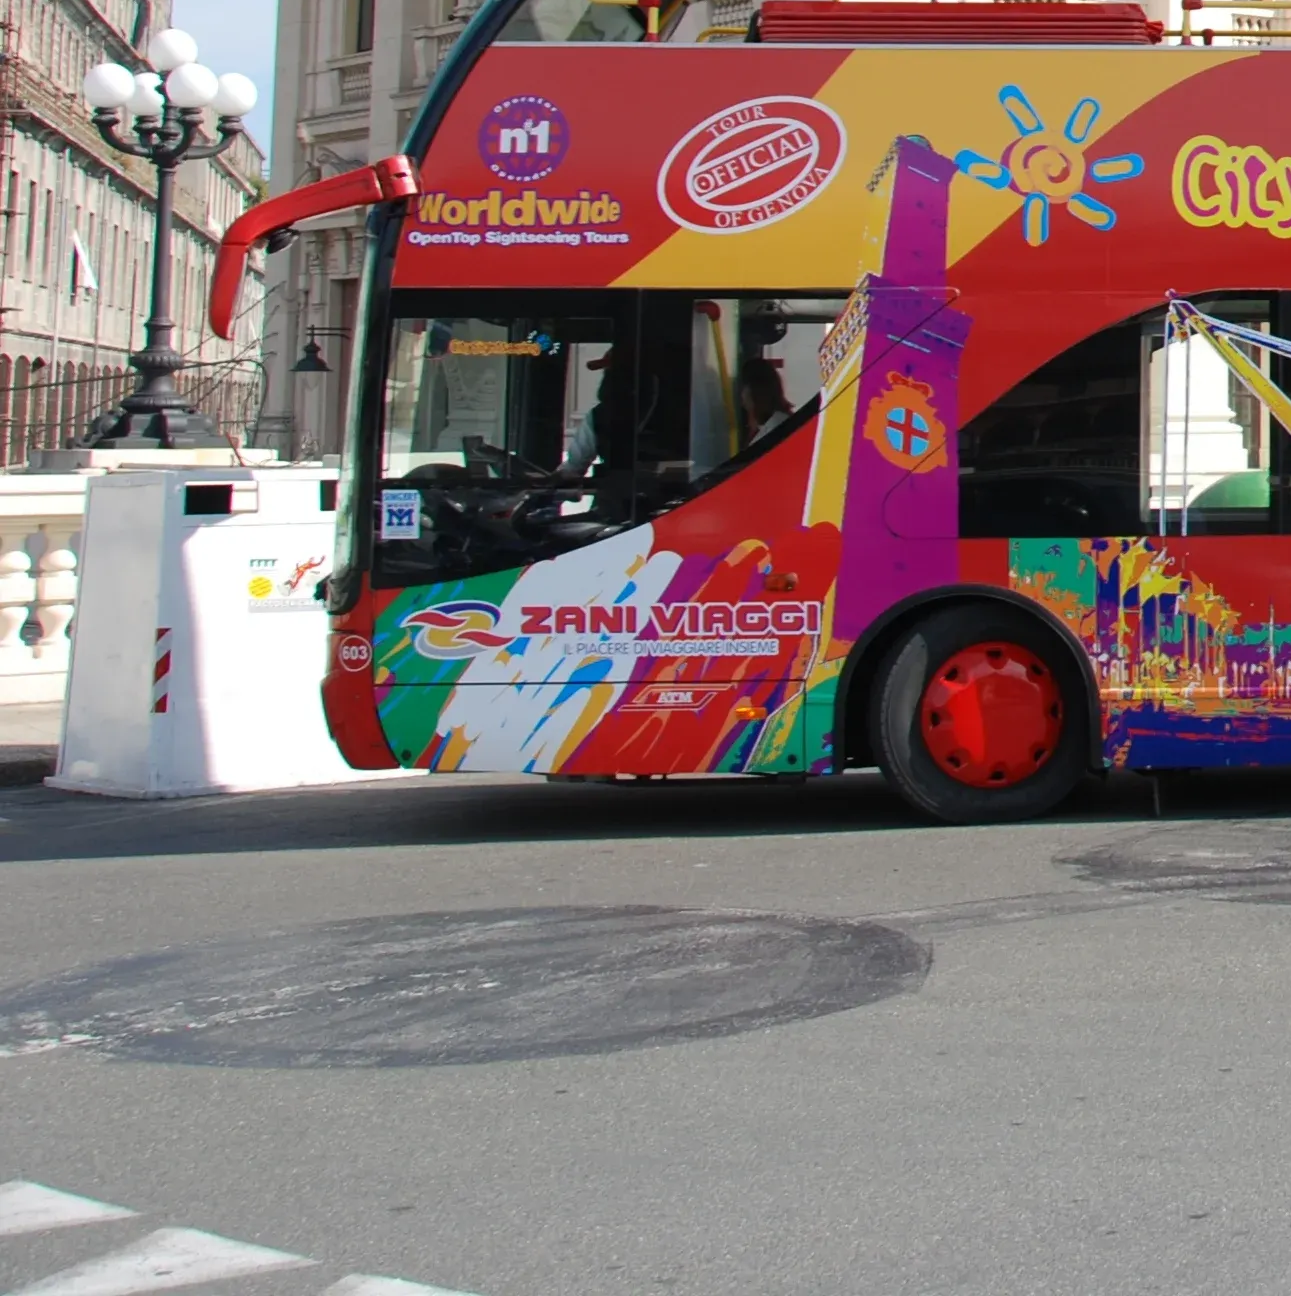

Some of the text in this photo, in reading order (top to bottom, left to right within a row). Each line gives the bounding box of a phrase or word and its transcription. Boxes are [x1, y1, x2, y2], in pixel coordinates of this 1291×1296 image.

[706, 105, 767, 138] TOUR
[693, 130, 813, 194] OFFICIAL
[417, 190, 622, 226] Worldwide
[714, 166, 831, 228] OF GENOVA
[408, 231, 630, 246] OpenTop Sightseeing Tours
[520, 602, 821, 636] ZANI VIAGGI
[342, 645, 368, 661] 603
[563, 640, 779, 655] IL PIACERE DI VIAGGIARE INSIEME
